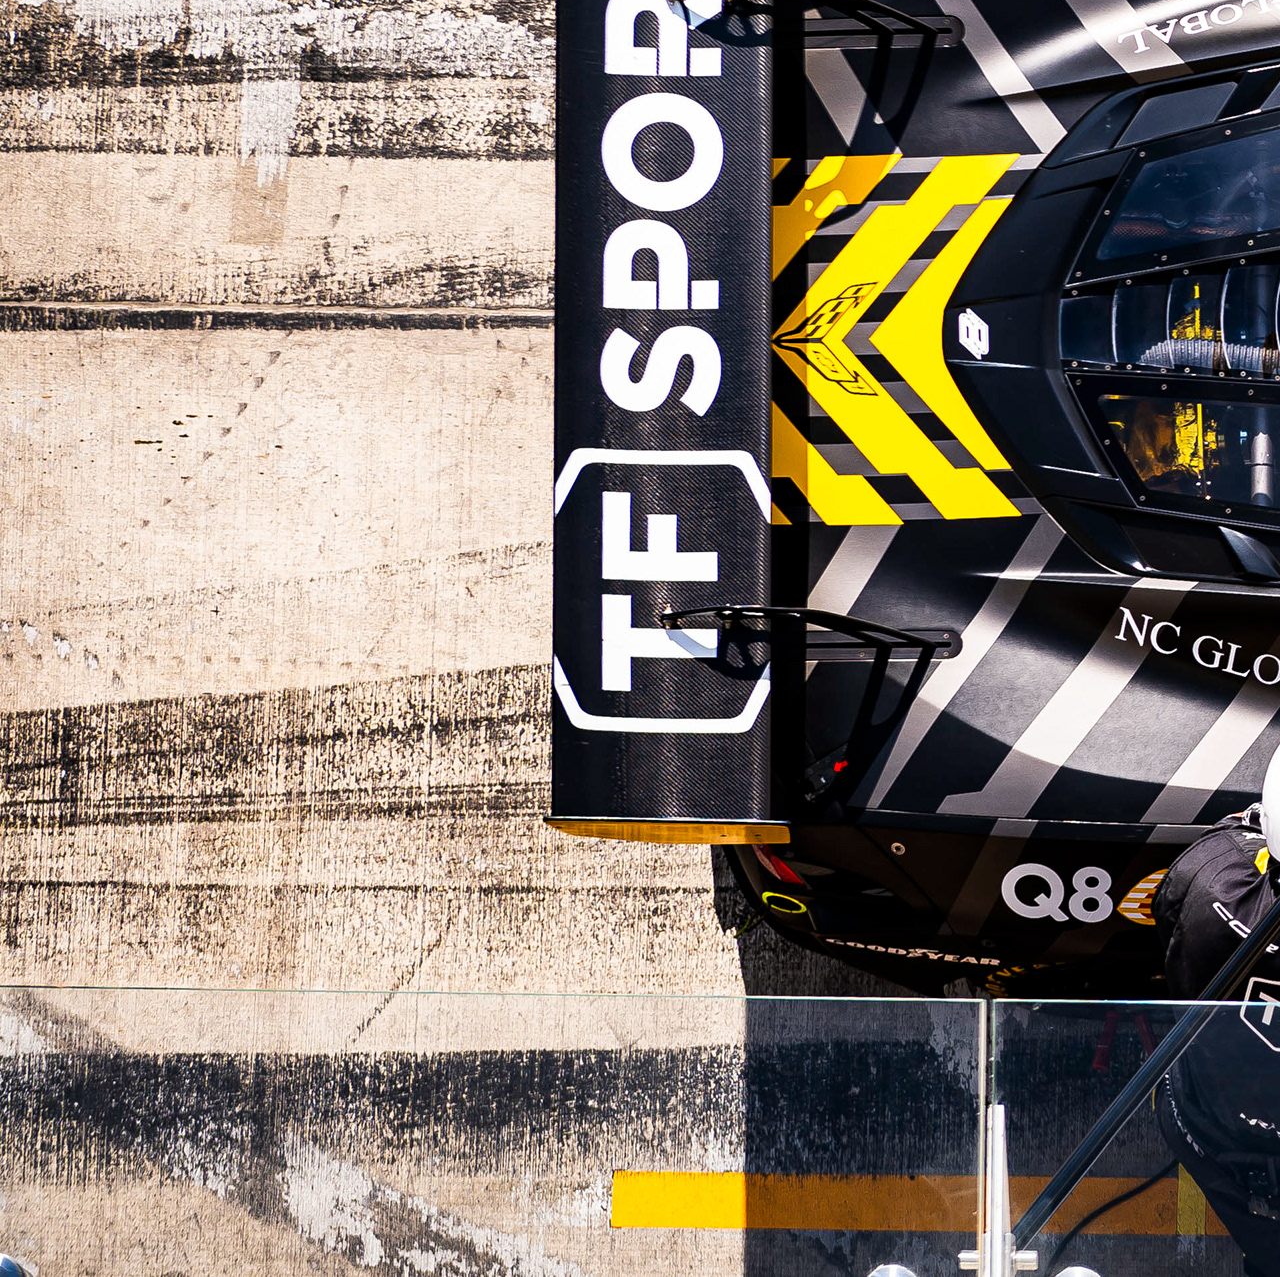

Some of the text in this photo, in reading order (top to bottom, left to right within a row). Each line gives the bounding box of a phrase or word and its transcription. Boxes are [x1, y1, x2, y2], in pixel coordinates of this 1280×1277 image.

[602, 491, 719, 692] TF
[1114, 606, 1182, 655] NC
[1001, 862, 1114, 923] Q8
[825, 938, 1000, 966] GOODYEAR
